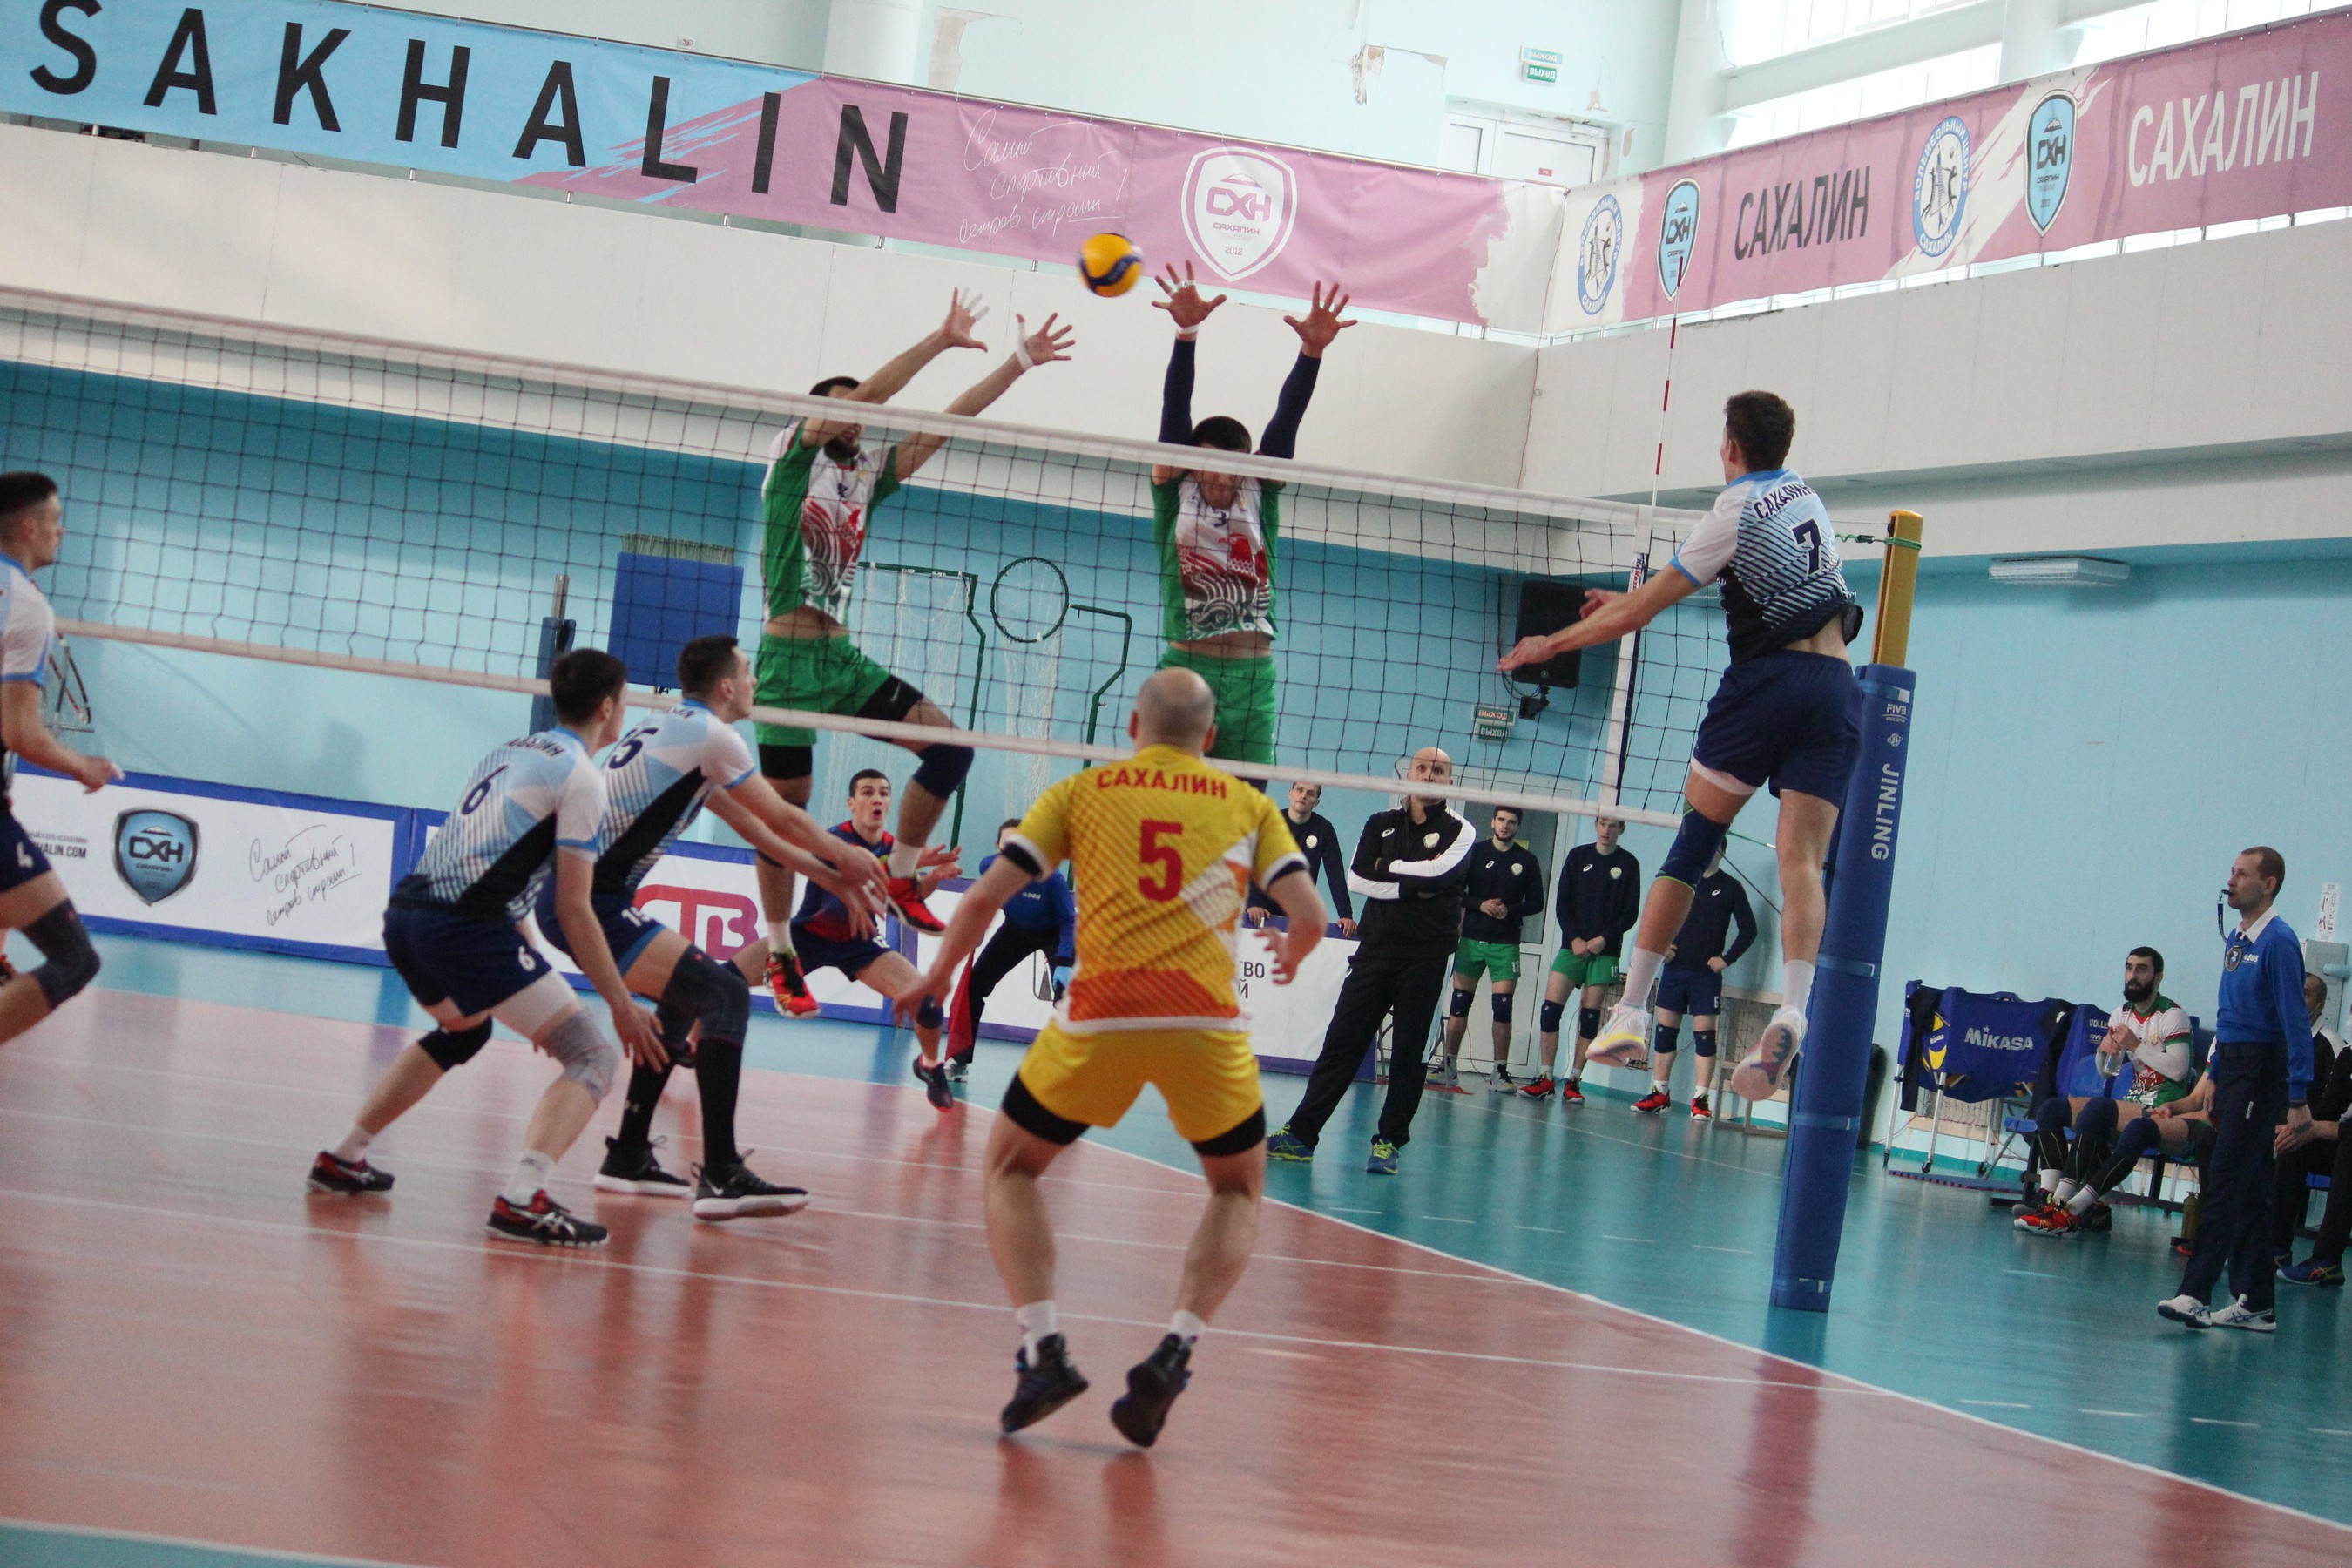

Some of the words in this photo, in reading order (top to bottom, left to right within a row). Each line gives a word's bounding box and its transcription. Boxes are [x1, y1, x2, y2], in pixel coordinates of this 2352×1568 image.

[1529, 66, 1556, 81] ВЫХОД
[30, 0, 908, 213] SAKHALIN
[2128, 71, 2319, 187] САХАЛИН
[1213, 221, 1260, 235] САХАЛИН
[1734, 165, 1871, 261] САХАЛИН
[1224, 245, 1243, 256] 2012
[1791, 518, 1822, 575] 7
[1478, 709, 1508, 720] ВЫХОД
[1480, 727, 1508, 740] ВЫХОД
[461, 764, 509, 815] 6
[1097, 767, 1227, 800] САХАЛИН
[1871, 763, 1900, 861] JINLING
[1139, 817, 1184, 903] 5
[517, 945, 537, 972] 6
